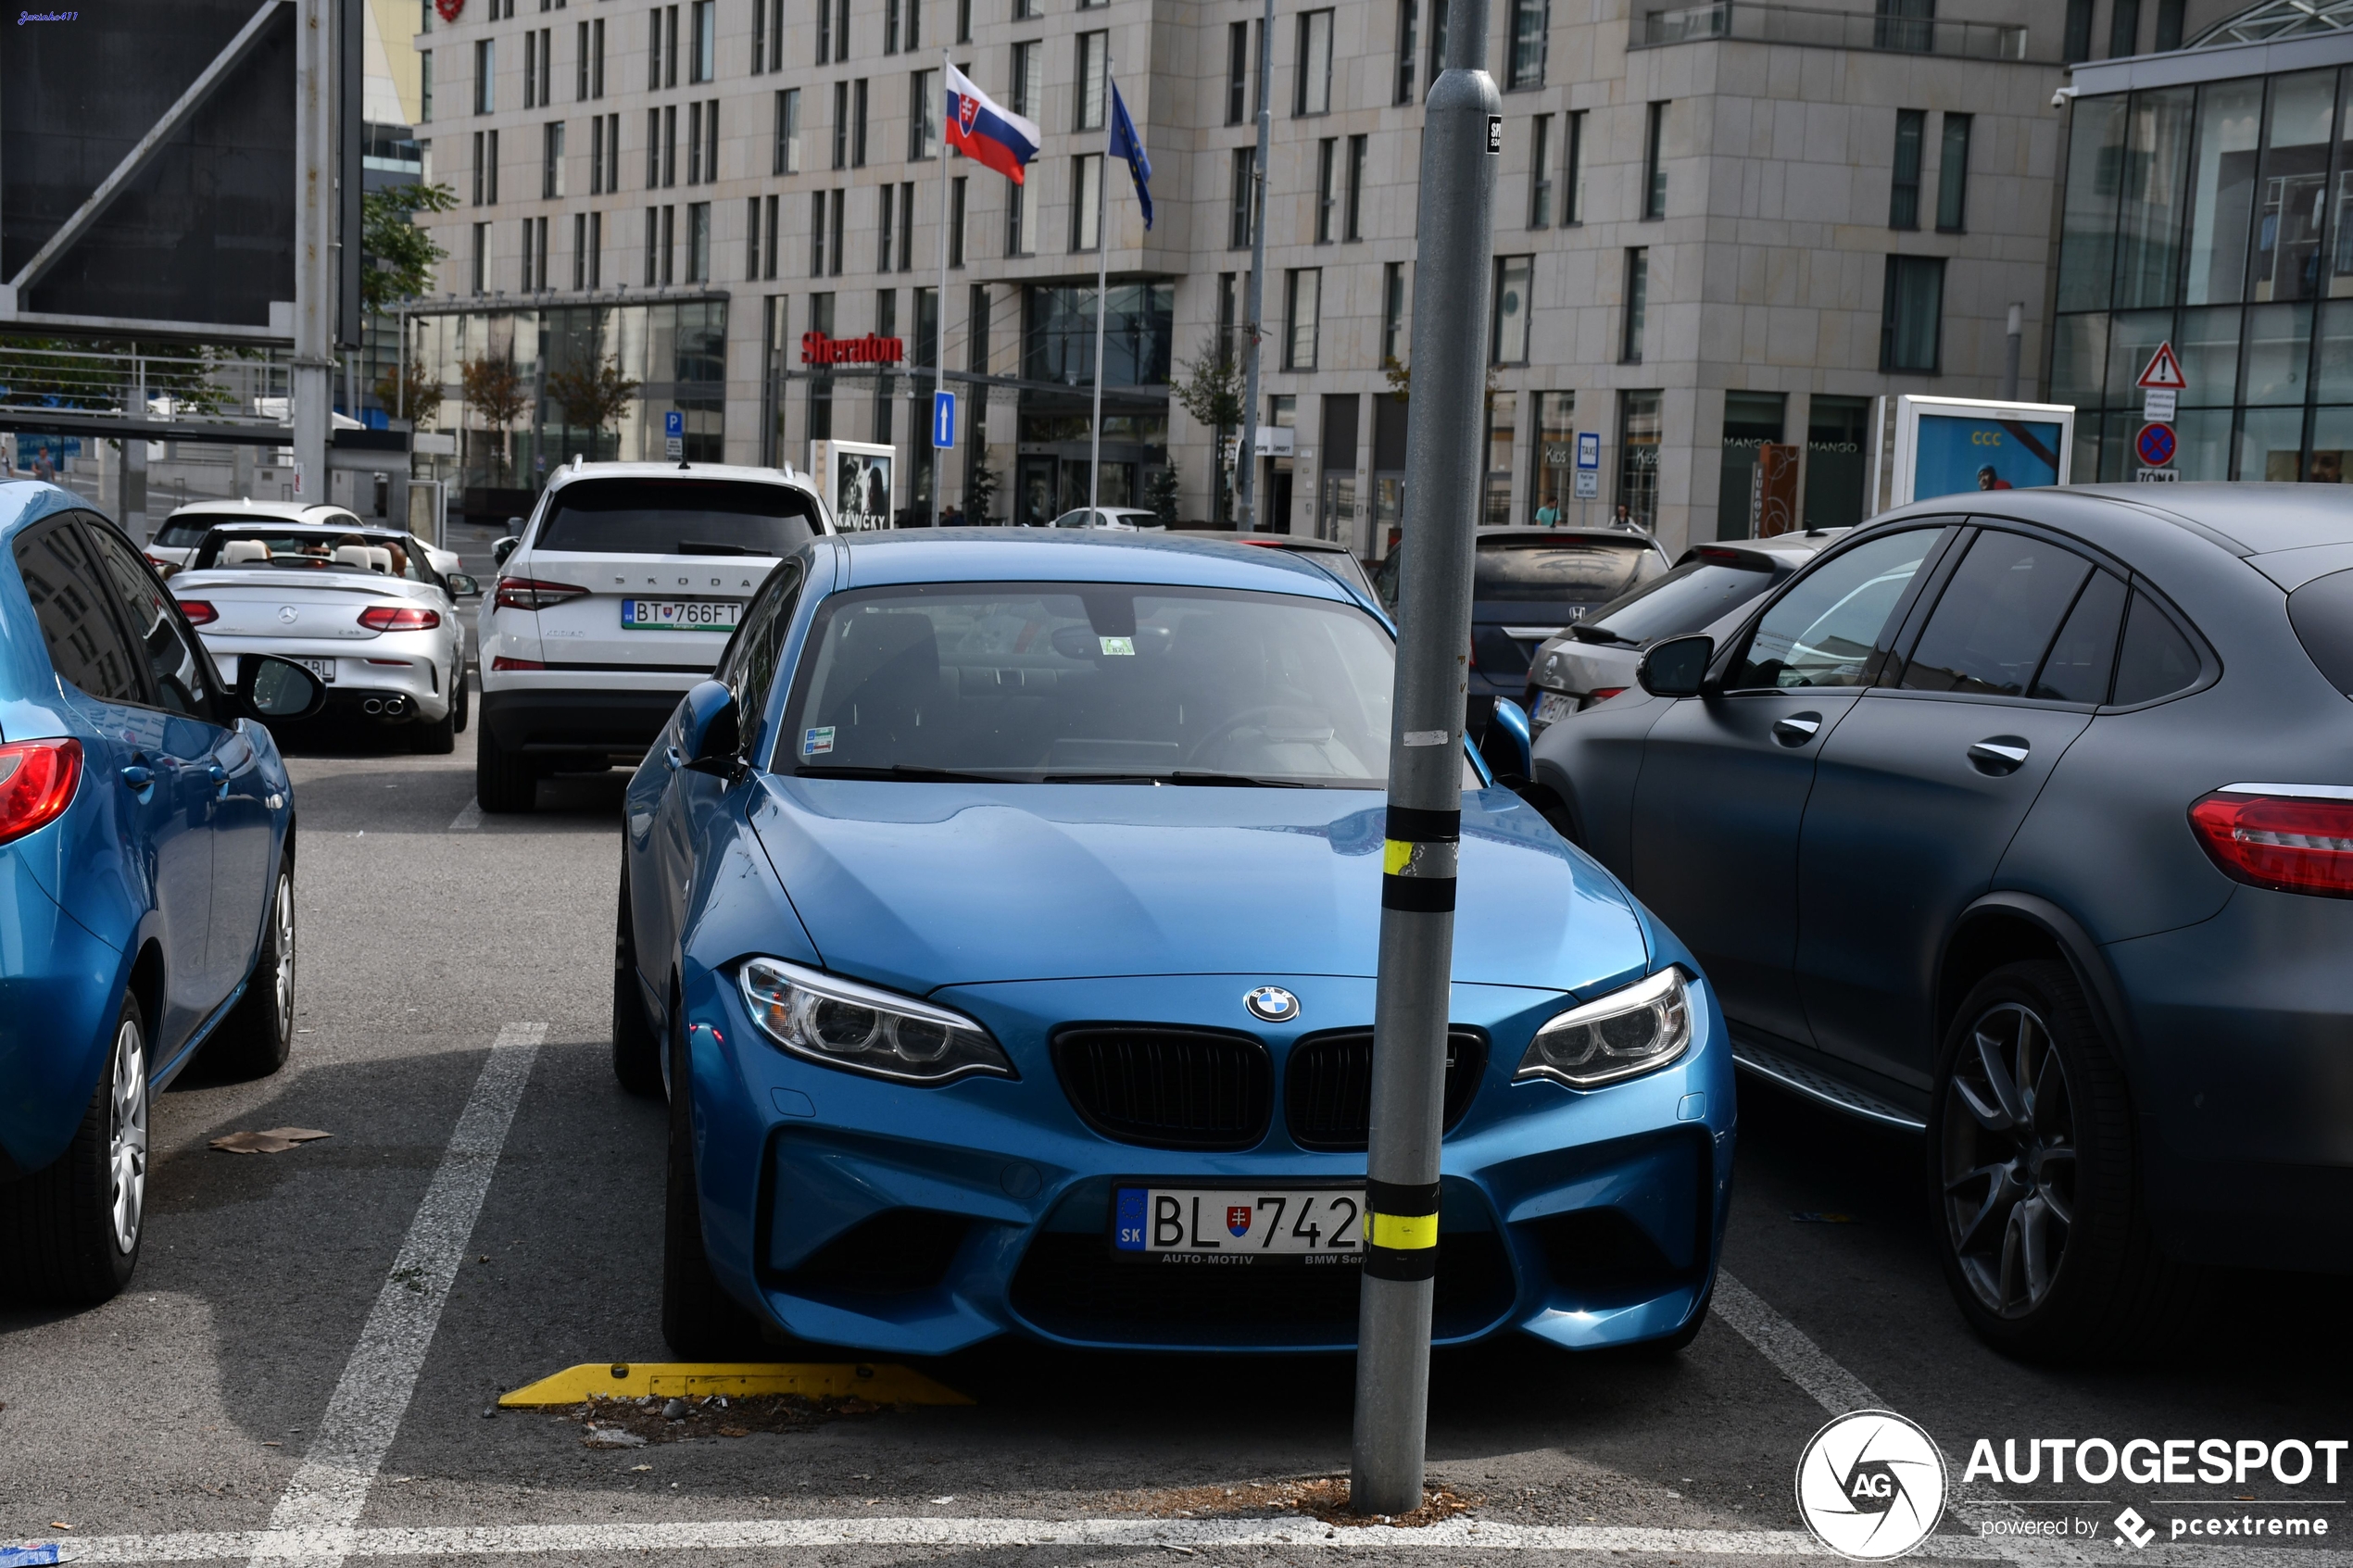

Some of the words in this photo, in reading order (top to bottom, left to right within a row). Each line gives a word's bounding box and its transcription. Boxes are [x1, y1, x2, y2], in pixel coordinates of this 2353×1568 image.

[801, 331, 903, 364] Sheraton
[669, 414, 679, 430] P
[1971, 431, 2002, 446] CCC
[1581, 445, 1596, 457] TAXI
[1808, 441, 1858, 453] MANGO
[636, 602, 662, 622] BT
[673, 603, 738, 624] 766FT
[1153, 1196, 1220, 1248] BL
[1256, 1197, 1358, 1248] 742
[1121, 1228, 1140, 1243] SK
[1162, 1253, 1254, 1265] AUTO-MOTIV
[1304, 1254, 1338, 1265] BMW
